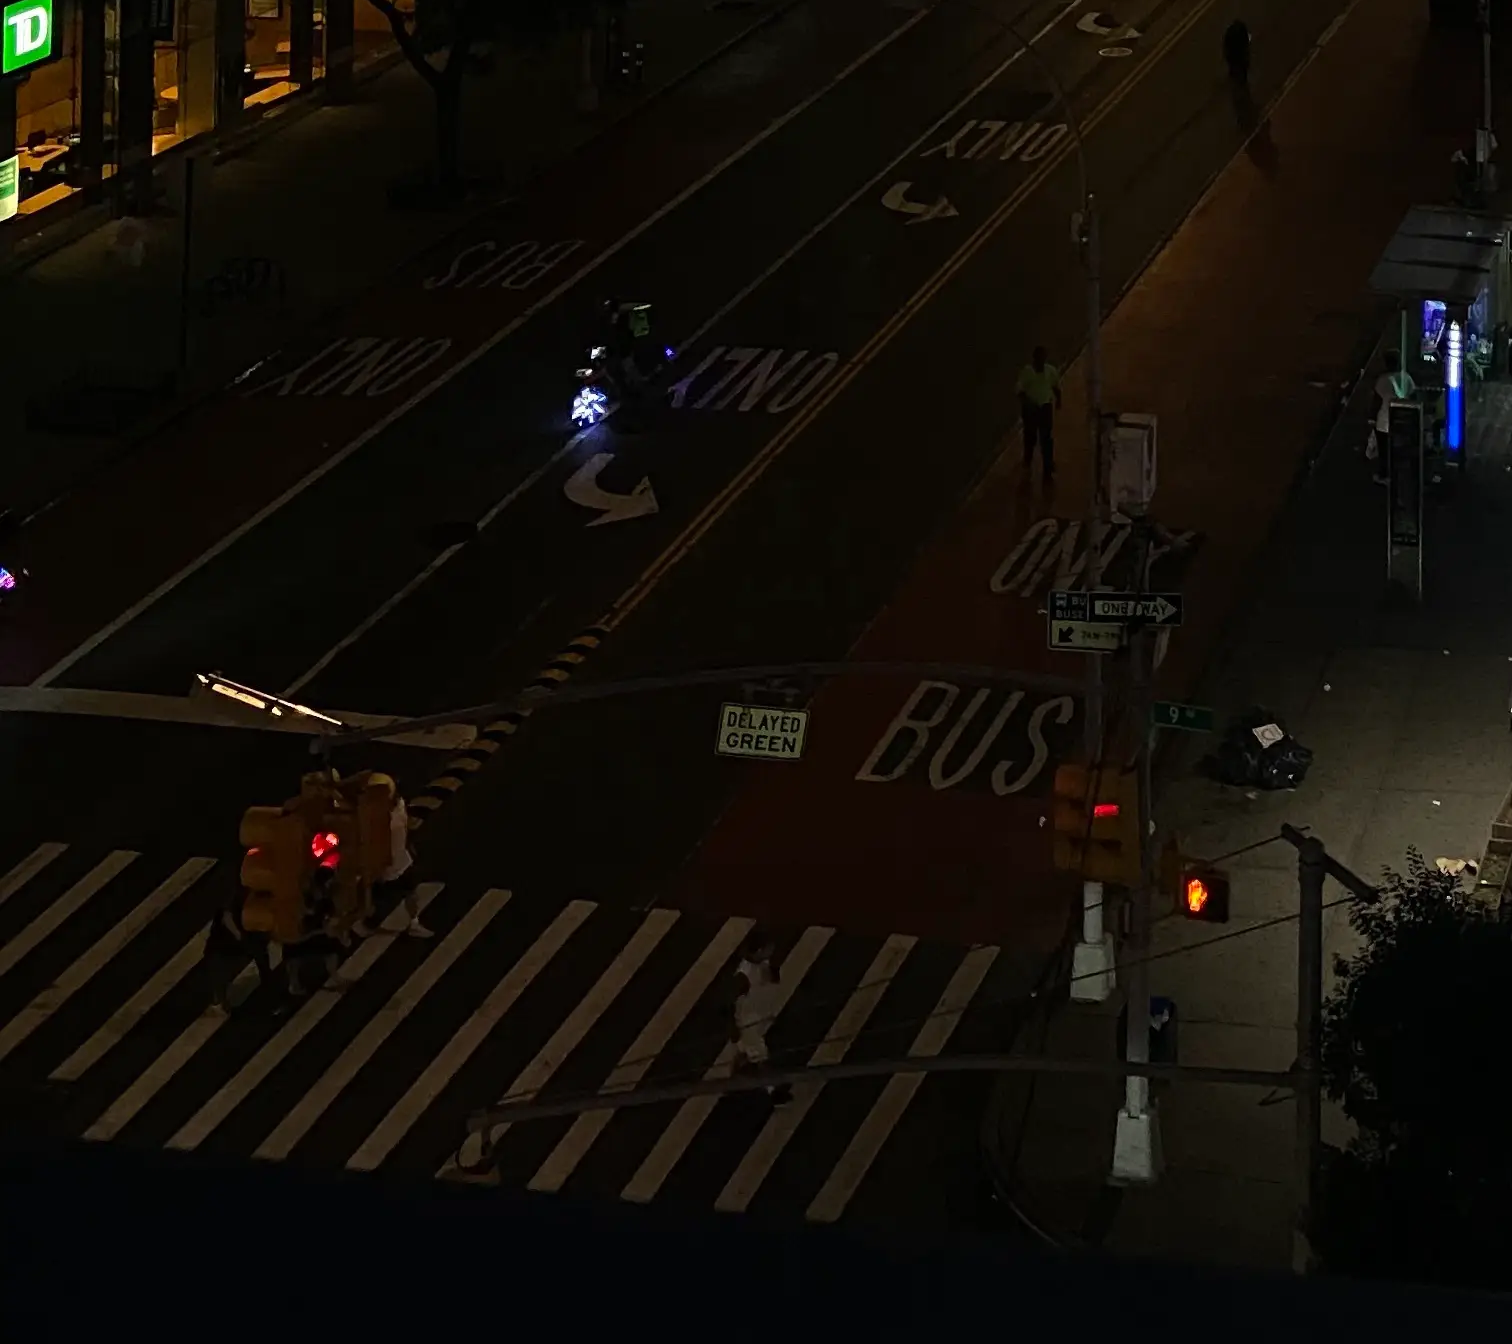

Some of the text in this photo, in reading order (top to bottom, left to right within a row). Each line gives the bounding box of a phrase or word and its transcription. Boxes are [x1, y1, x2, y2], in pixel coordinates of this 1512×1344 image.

[8, 5, 48, 57] TD
[920, 118, 1068, 162] ONLY
[422, 238, 586, 291] BUS
[240, 335, 453, 397] ONLY
[667, 344, 839, 414] ONLY
[1140, 601, 1168, 616] WAY
[727, 711, 801, 733] DELAYED
[855, 679, 1076, 796] BUS
[1169, 706, 1179, 724] 9
[726, 732, 797, 753] GREEN
